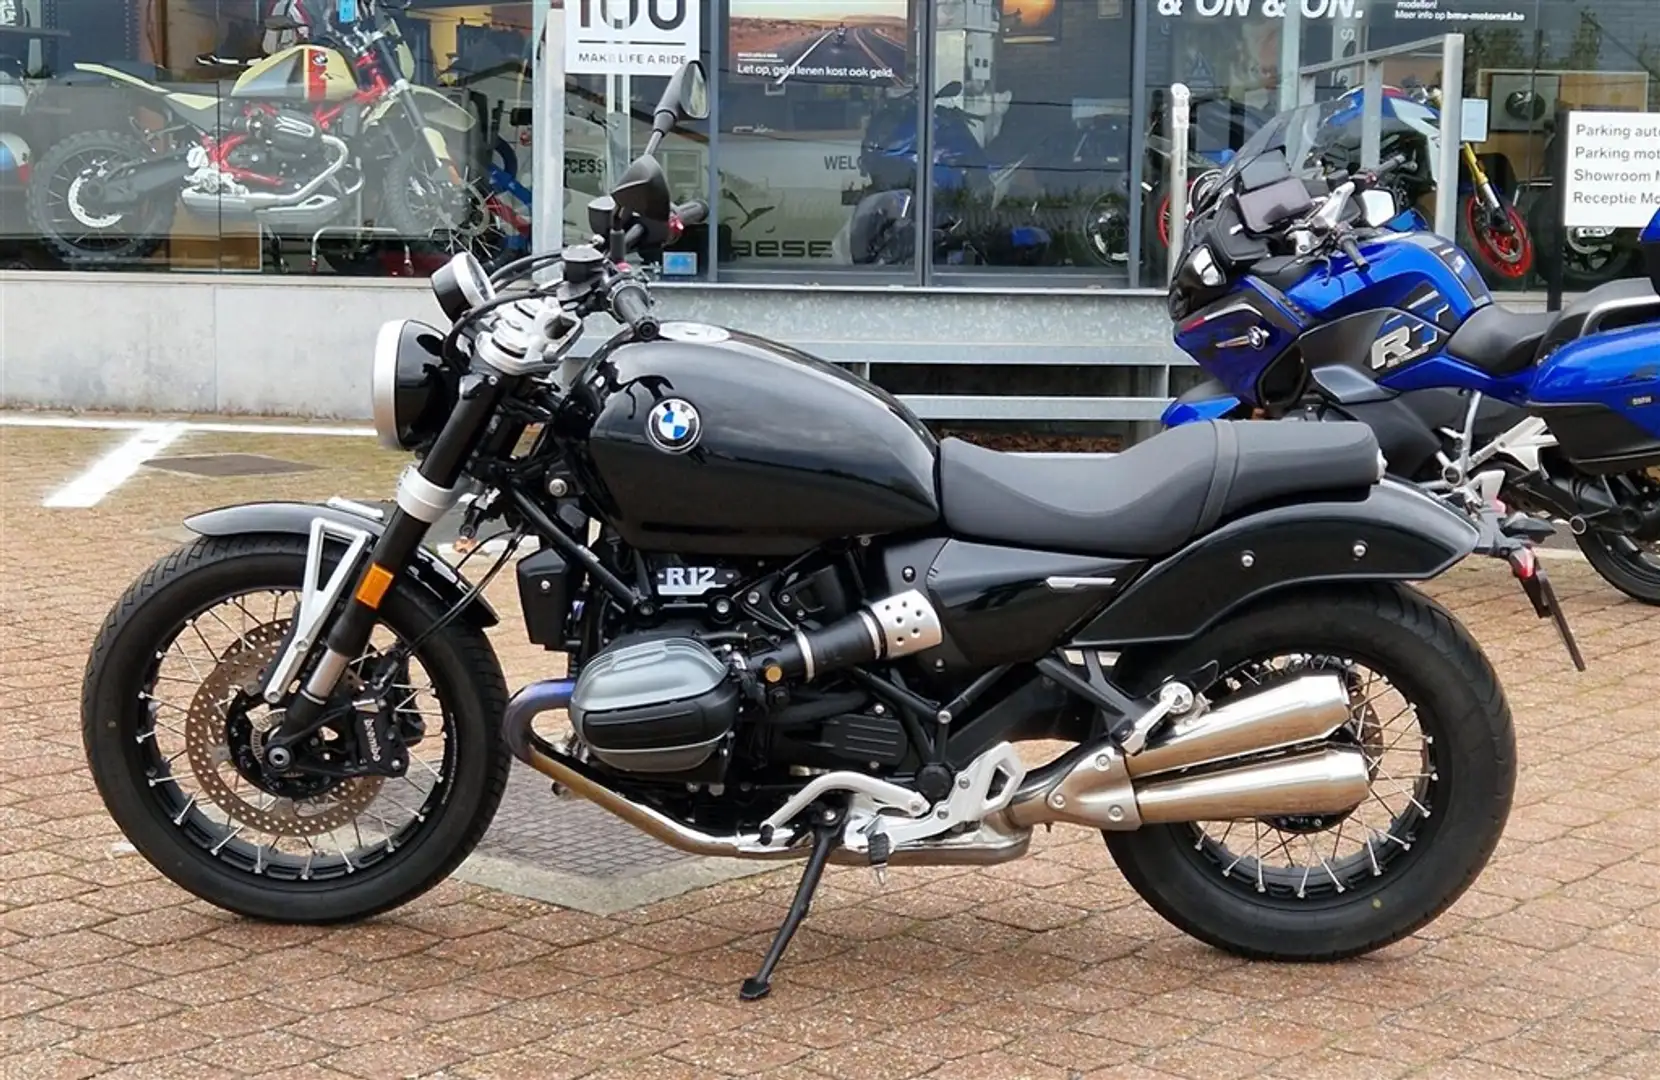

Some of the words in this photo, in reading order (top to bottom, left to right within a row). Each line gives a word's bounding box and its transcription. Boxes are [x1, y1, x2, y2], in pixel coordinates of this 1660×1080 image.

[578, 53, 615, 63] MAK
[737, 63, 754, 74] Let
[755, 66, 771, 76] op,
[797, 65, 825, 76] lenen
[826, 65, 847, 76] kost
[849, 66, 869, 76] ook
[870, 67, 895, 79] geld.
[1576, 124, 1631, 140] Parking
[1634, 127, 1660, 138] aut
[1575, 146, 1631, 162] Parking
[1573, 168, 1651, 181] Showroom
[1573, 191, 1637, 206] Receptie
[363, 718, 381, 762] brembo
